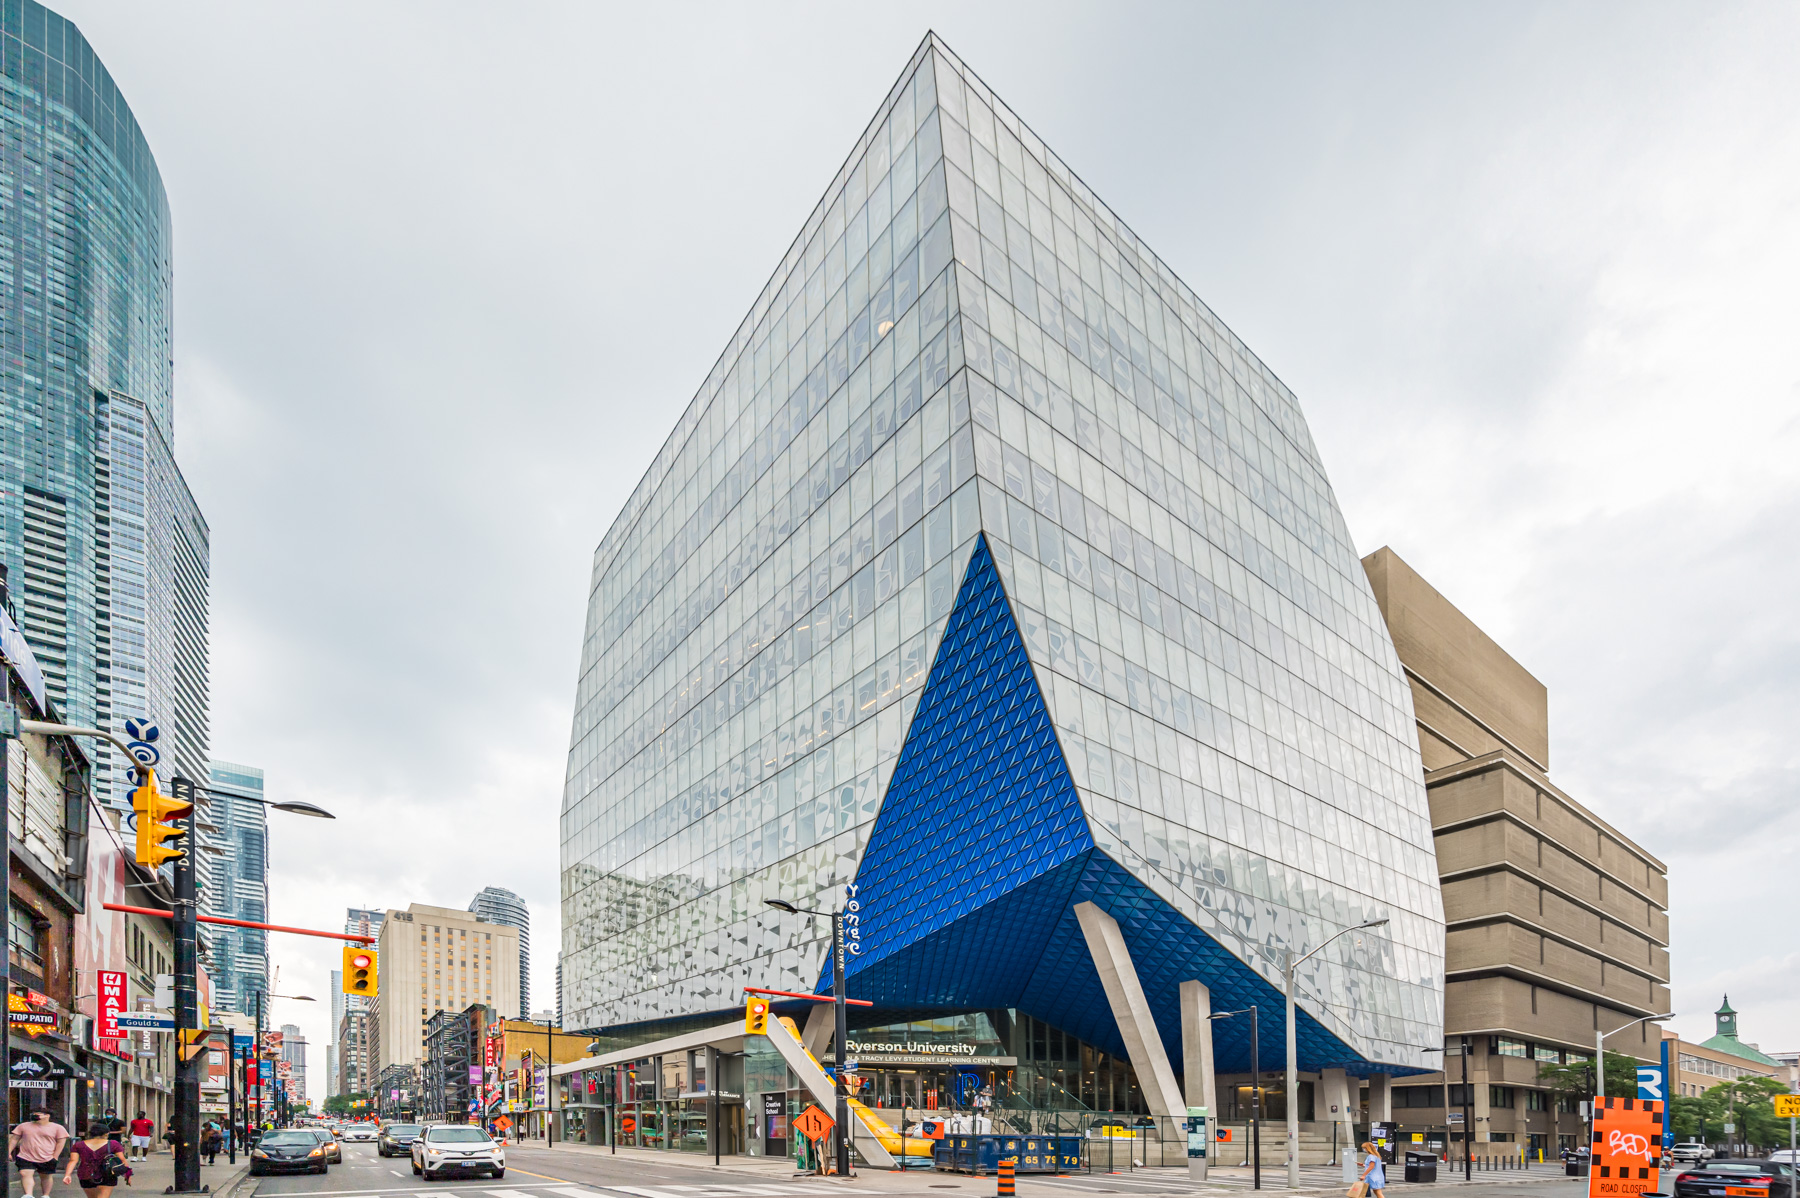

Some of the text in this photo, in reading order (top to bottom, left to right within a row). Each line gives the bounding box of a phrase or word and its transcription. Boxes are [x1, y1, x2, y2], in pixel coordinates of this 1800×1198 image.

[394, 911, 413, 921] 415
[847, 883, 861, 955] Yonge
[837, 916, 845, 969] DOWNTOWN
[104, 986, 120, 1028] MART
[30, 1015, 53, 1023] PATIO
[126, 1019, 151, 1027] Gould
[845, 1040, 977, 1055] Ryerson University
[1637, 1069, 1662, 1098] R
[924, 1125, 934, 1135] sdg
[1601, 1184, 1648, 1193] ROAD CLOSED
